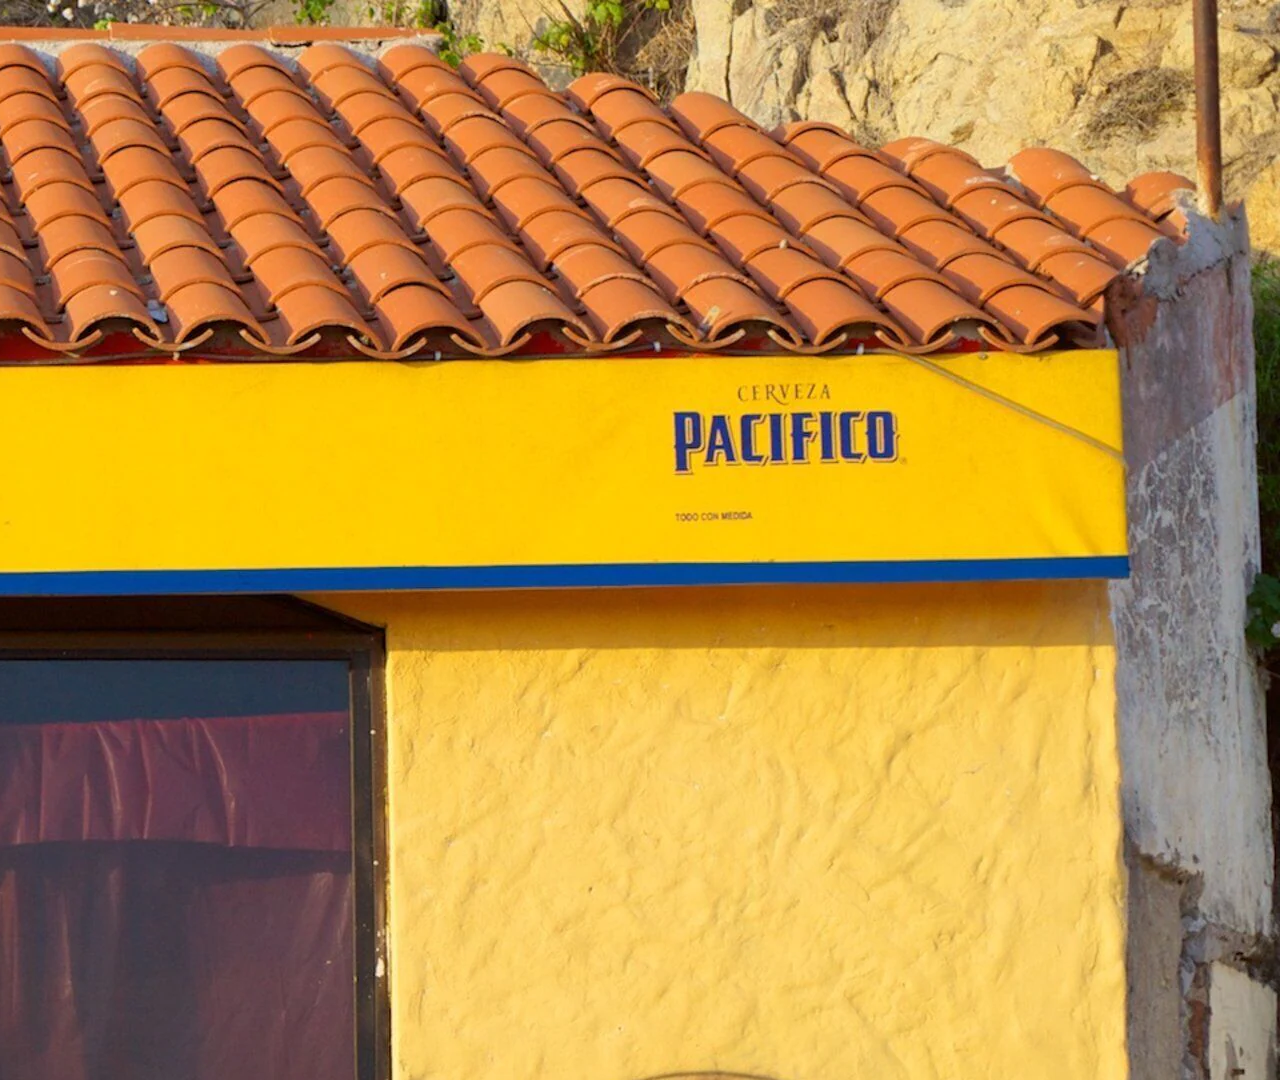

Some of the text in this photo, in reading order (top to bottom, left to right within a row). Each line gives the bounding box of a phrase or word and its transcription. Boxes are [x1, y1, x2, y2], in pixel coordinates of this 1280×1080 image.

[737, 382, 831, 406] CERVEZA
[673, 410, 901, 475] PACIFICO
[675, 511, 753, 521] TODO CON MEDIDA
